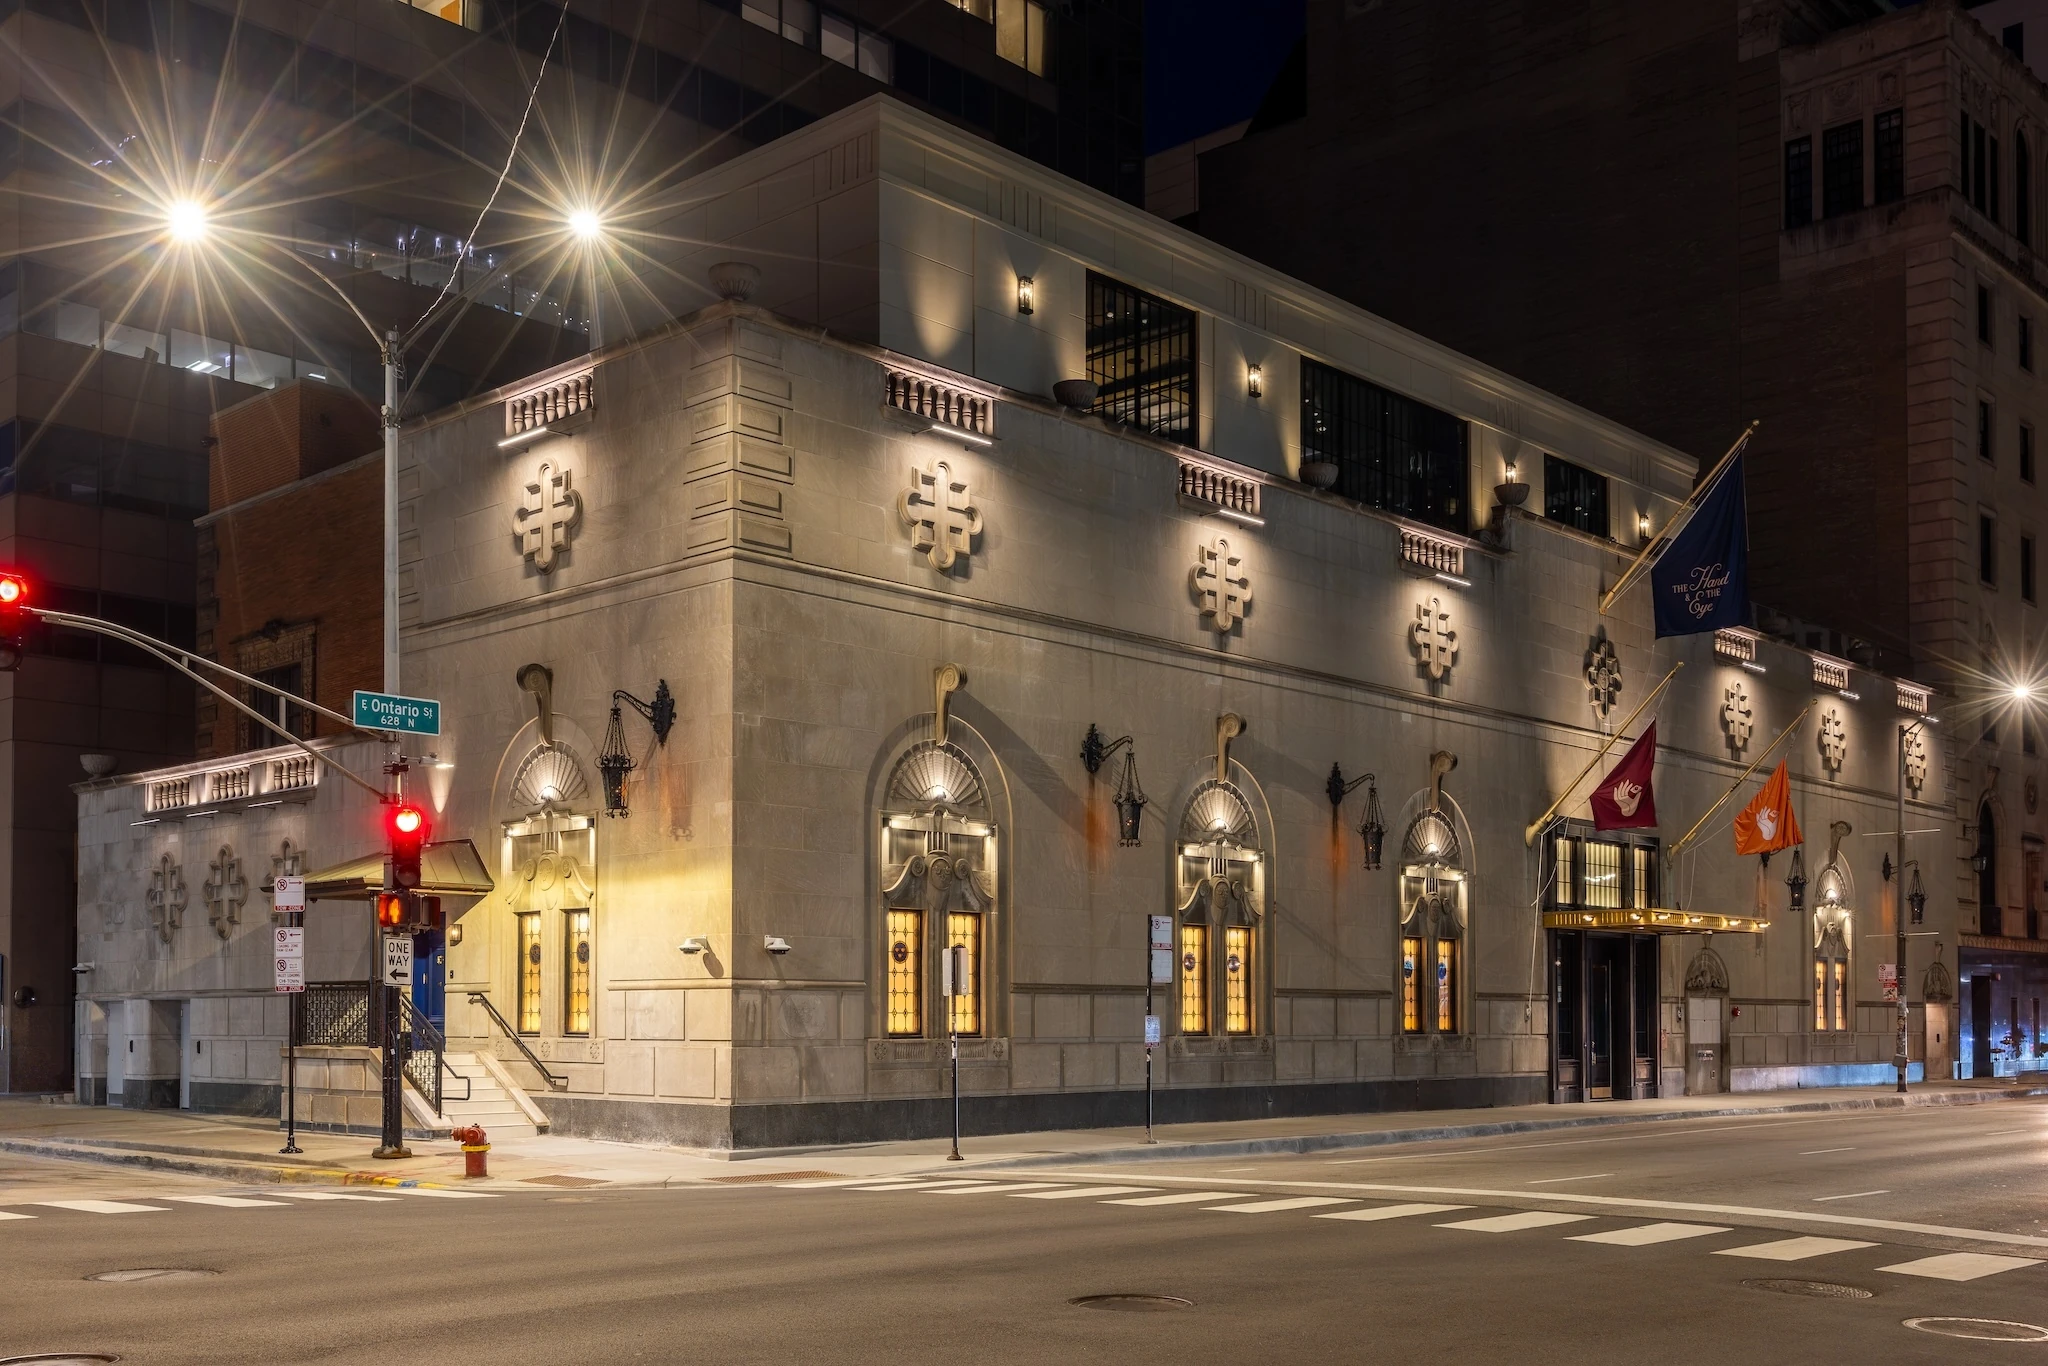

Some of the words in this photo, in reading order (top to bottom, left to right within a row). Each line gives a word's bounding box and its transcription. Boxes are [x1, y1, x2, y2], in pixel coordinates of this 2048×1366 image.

[1672, 584, 1688, 593] THE
[1689, 563, 1730, 591] Hand
[1706, 588, 1721, 598] THE
[1689, 591, 1713, 619] Eye
[361, 699, 367, 711] E
[371, 699, 419, 717] Ontario
[423, 707, 432, 719] St
[381, 715, 400, 726] 628
[407, 718, 415, 728] N
[388, 942, 409, 954] ONE
[388, 955, 409, 967] WAY
